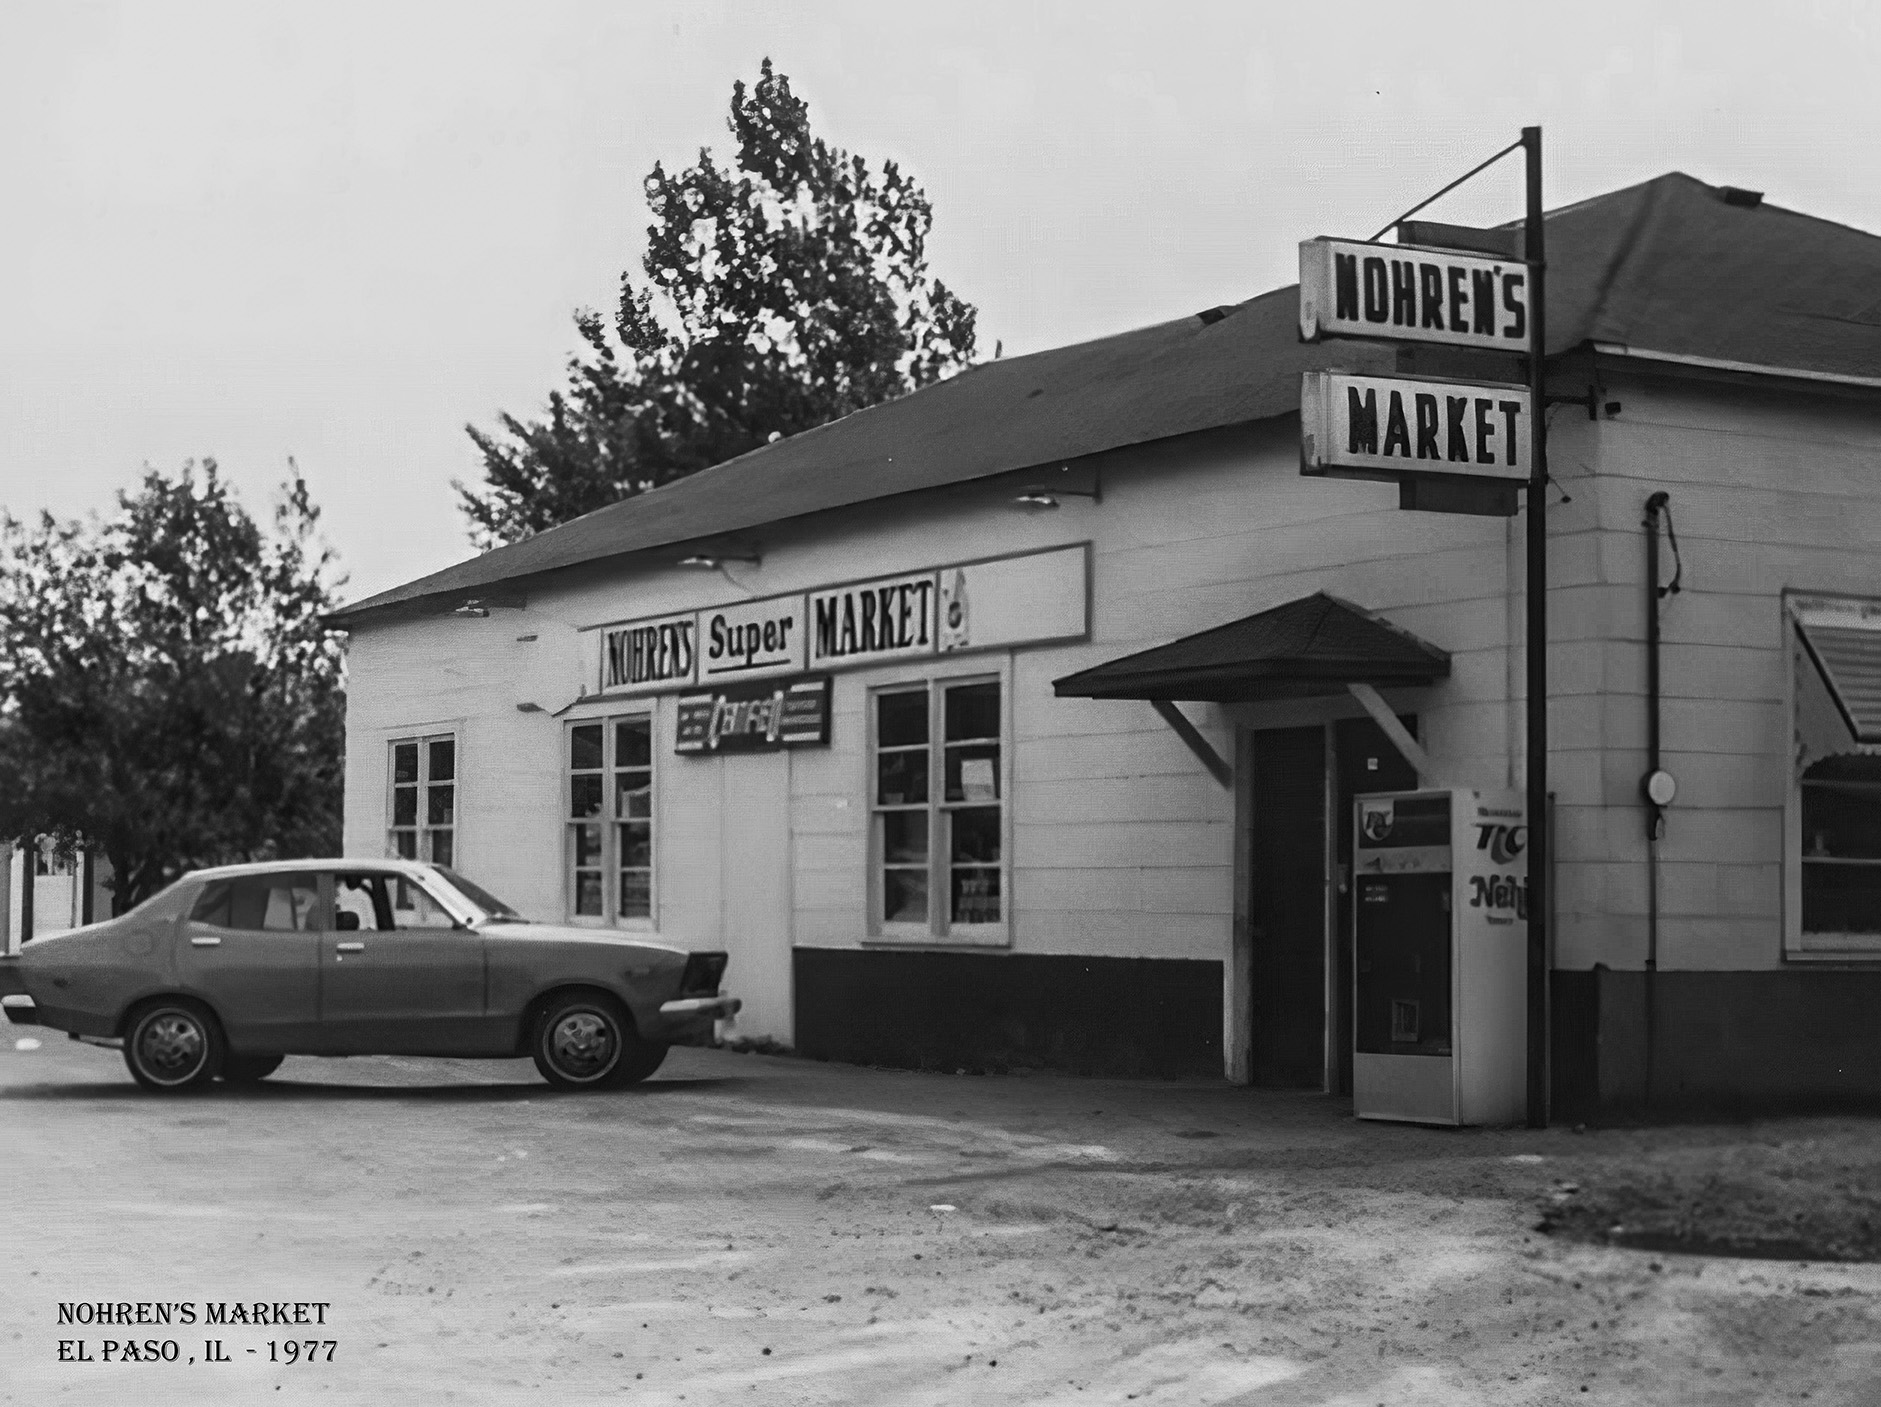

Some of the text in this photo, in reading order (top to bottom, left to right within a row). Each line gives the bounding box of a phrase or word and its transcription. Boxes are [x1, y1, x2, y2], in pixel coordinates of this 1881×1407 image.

[1335, 253, 1526, 339] NOHREN'S
[1347, 386, 1521, 466] MARKET
[708, 613, 794, 668] Super
[815, 580, 934, 658] MARKET
